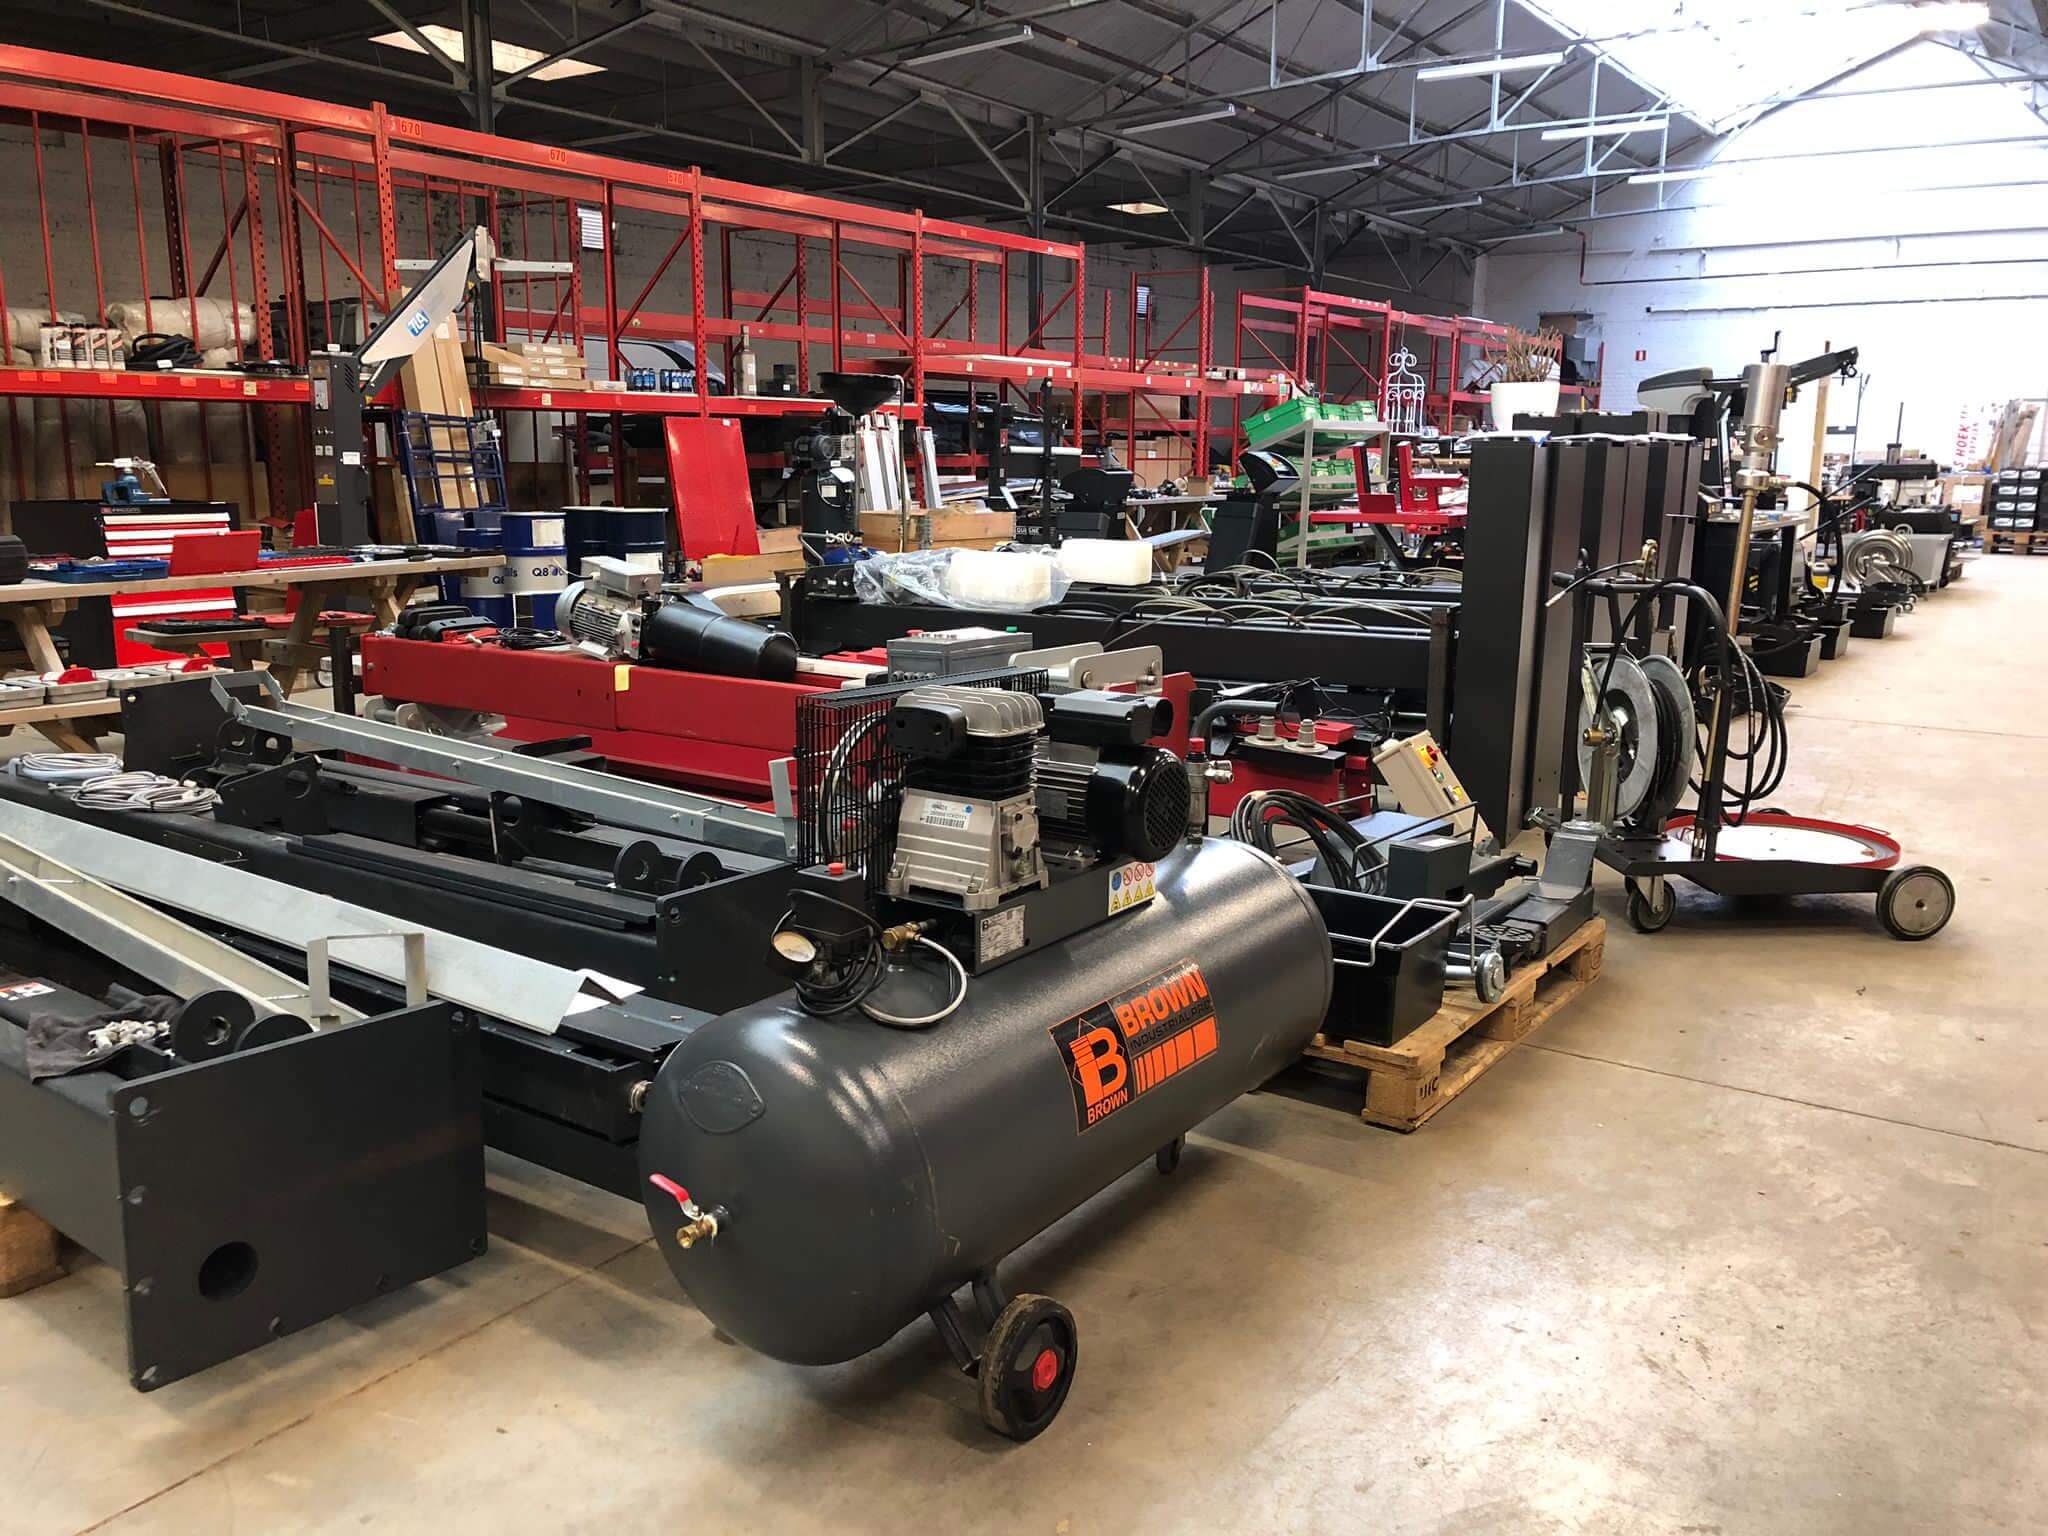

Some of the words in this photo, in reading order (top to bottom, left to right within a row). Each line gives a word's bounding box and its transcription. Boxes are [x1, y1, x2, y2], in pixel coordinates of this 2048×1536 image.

[532, 567, 549, 577] Q8
[1115, 969, 1208, 1038] BROWN
[1087, 1088, 1129, 1125] BROWN
